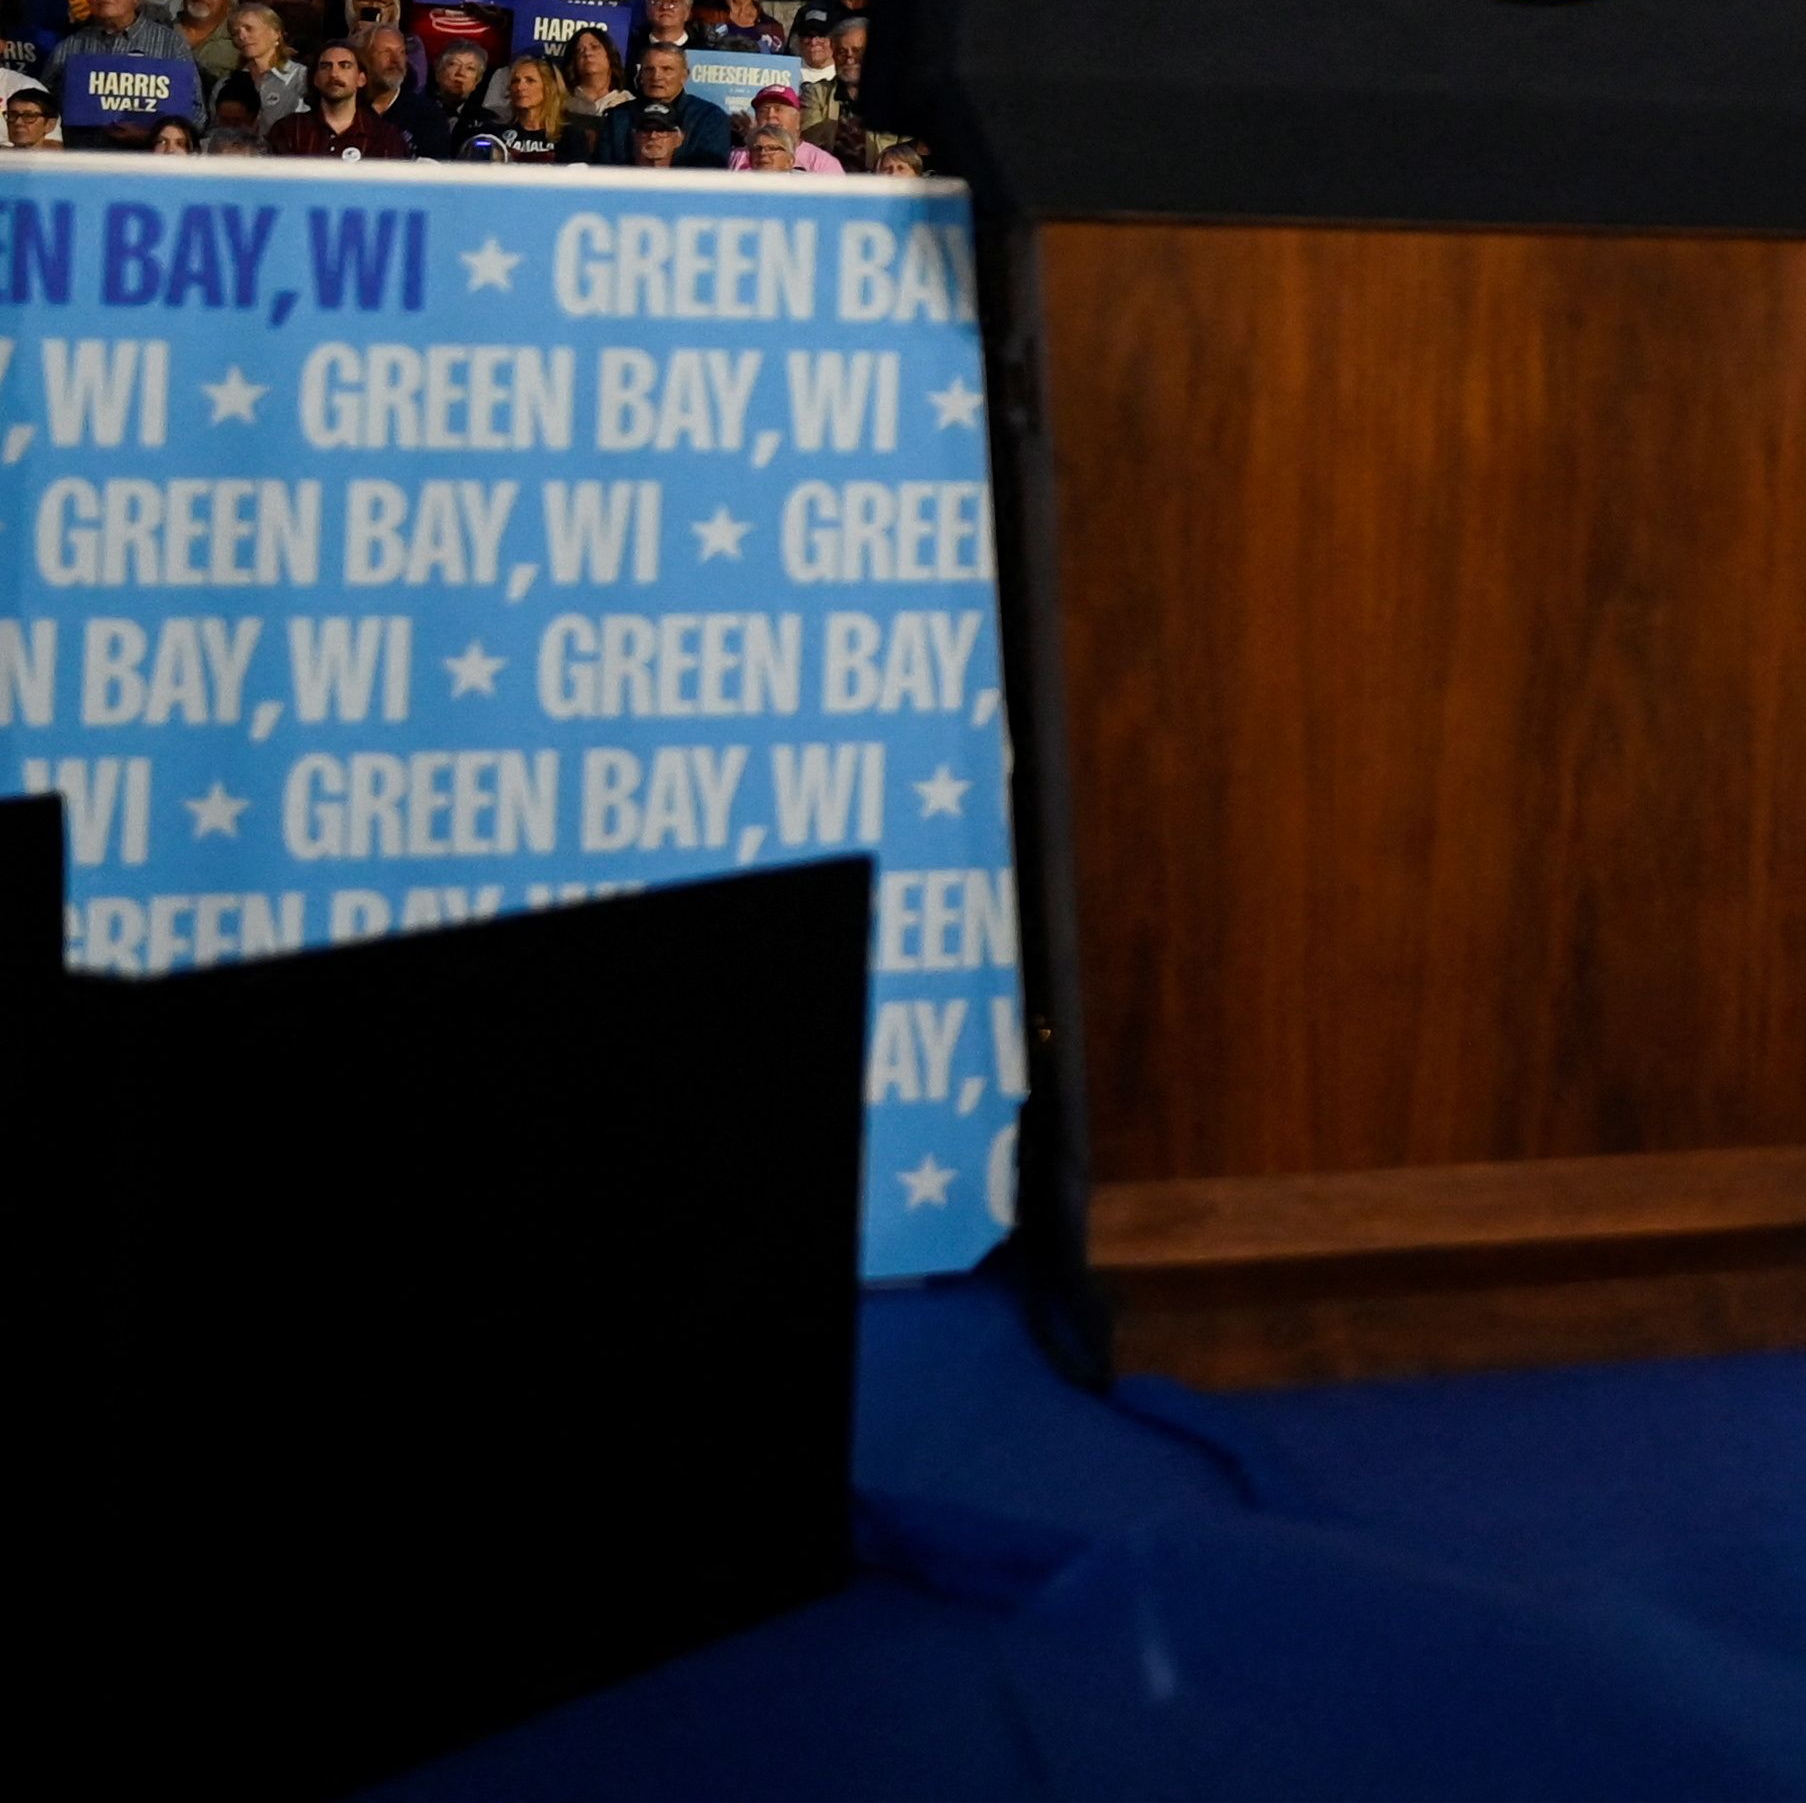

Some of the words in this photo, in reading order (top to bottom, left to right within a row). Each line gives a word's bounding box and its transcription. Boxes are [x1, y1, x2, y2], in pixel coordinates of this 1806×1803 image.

[89, 71, 170, 99] HARRIS
[100, 96, 157, 113] WALZ
[691, 64, 792, 86] CHEESEHEADS
[554, 212, 818, 321] GREEN
[299, 343, 575, 452] GREEN
[34, 477, 322, 588] GREEN
[783, 479, 997, 583] GREE
[538, 611, 802, 720] GREEN
[283, 751, 558, 861] GREEN
